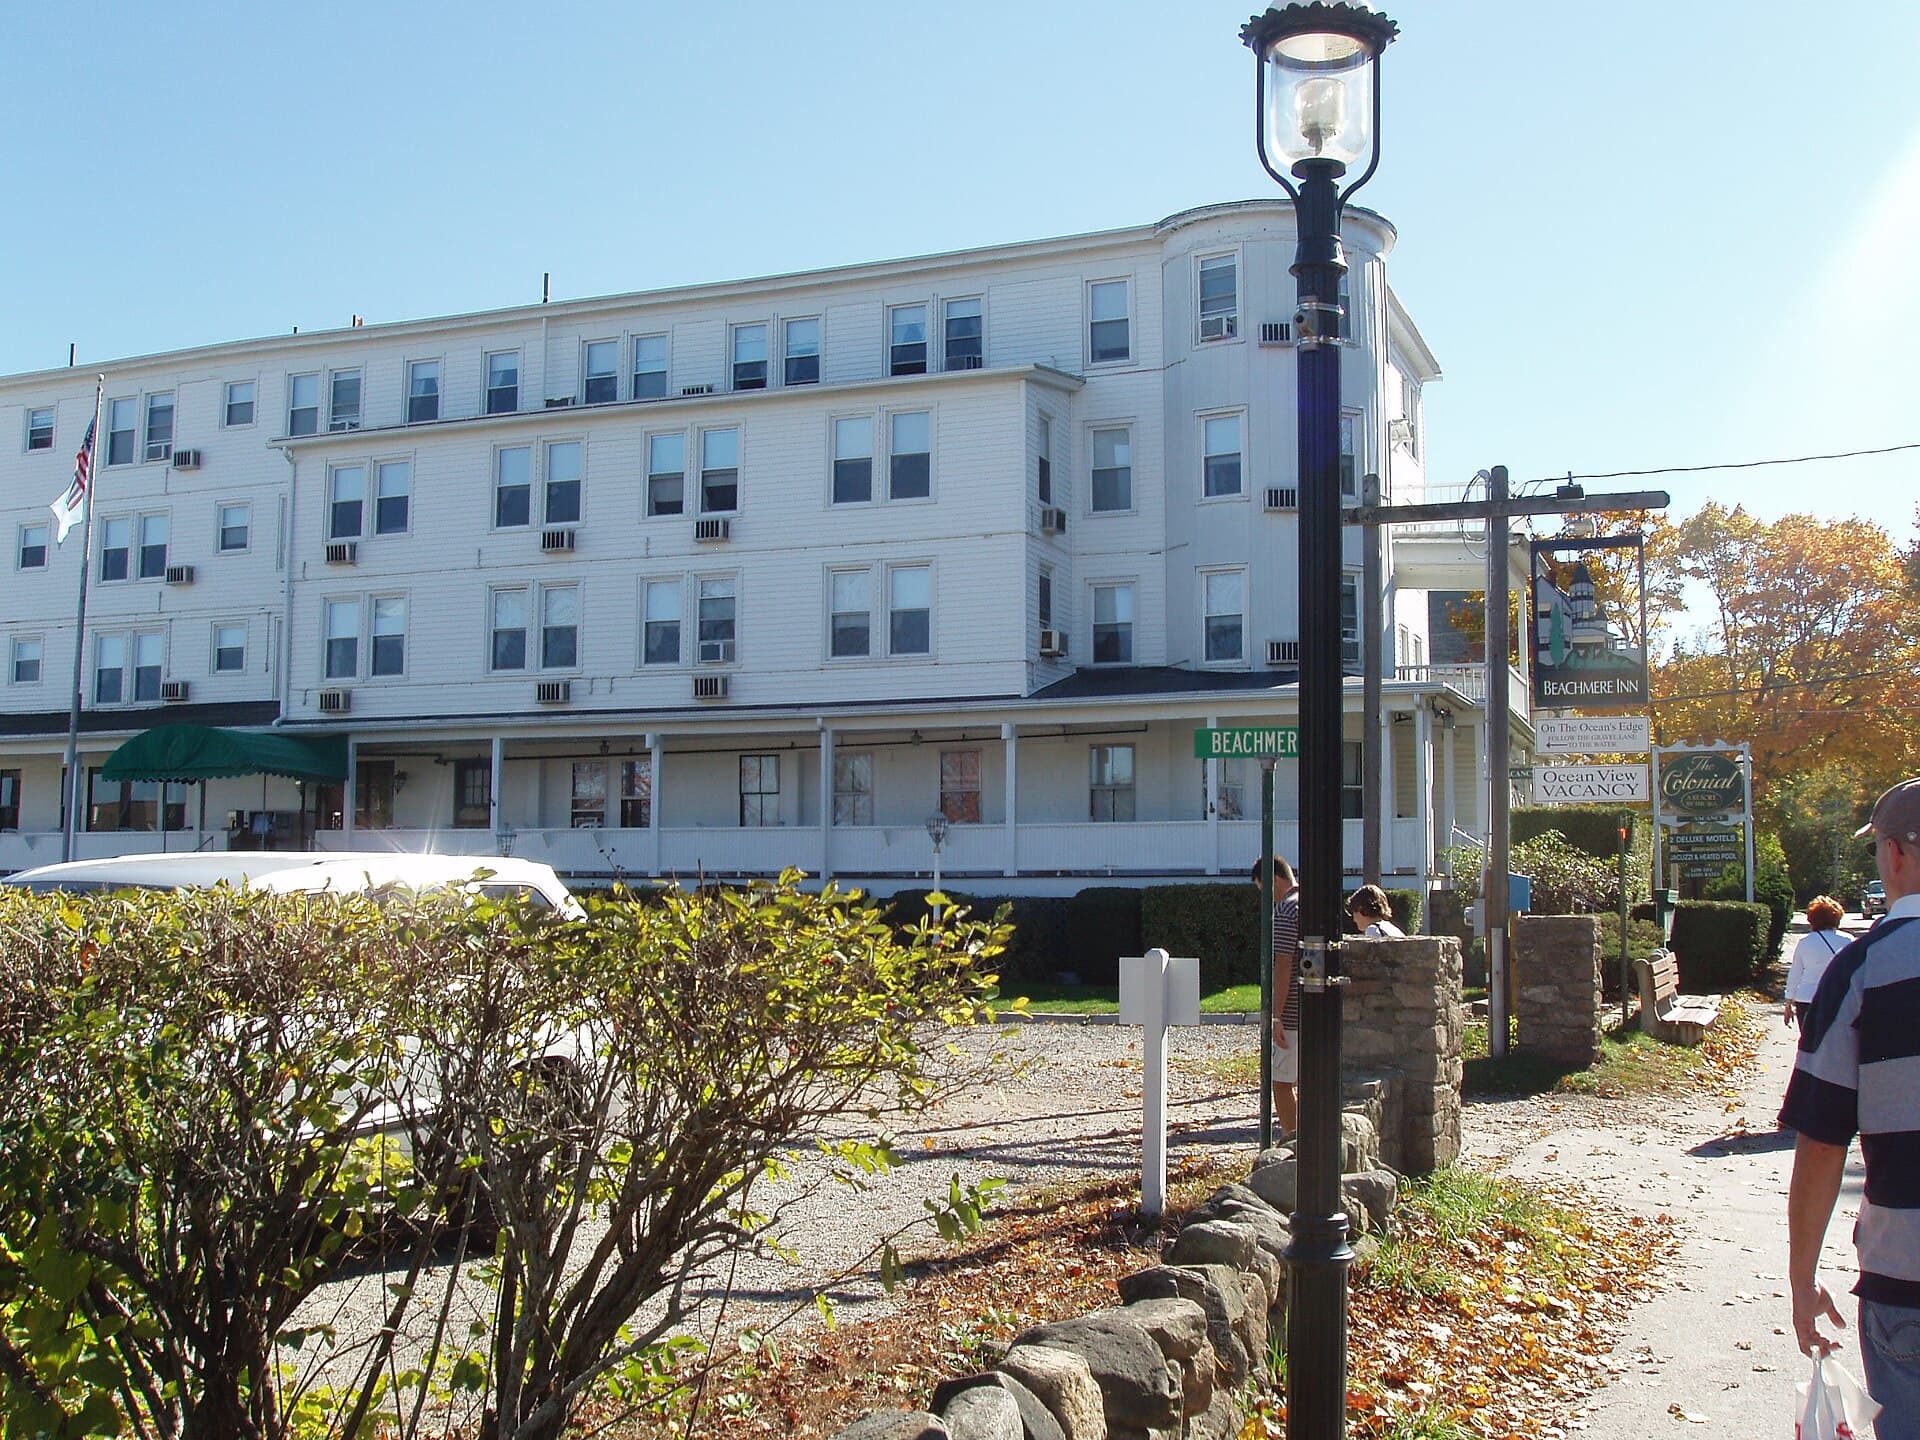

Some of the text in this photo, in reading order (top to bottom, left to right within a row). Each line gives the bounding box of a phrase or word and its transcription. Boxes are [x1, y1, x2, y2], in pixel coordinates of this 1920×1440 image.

[1544, 679, 1639, 695] BEACHMERE INN
[1541, 722, 1643, 734] On The Ocean's Edge
[1212, 731, 1297, 753] BEACHMER
[1688, 756, 1715, 771] The
[1543, 769, 1638, 782] Ocean View
[1542, 783, 1639, 797] VACANCY
[1664, 770, 1738, 796] Colonial
[1676, 835, 1704, 843] DELUXE
[1706, 834, 1736, 842] MOTELS
